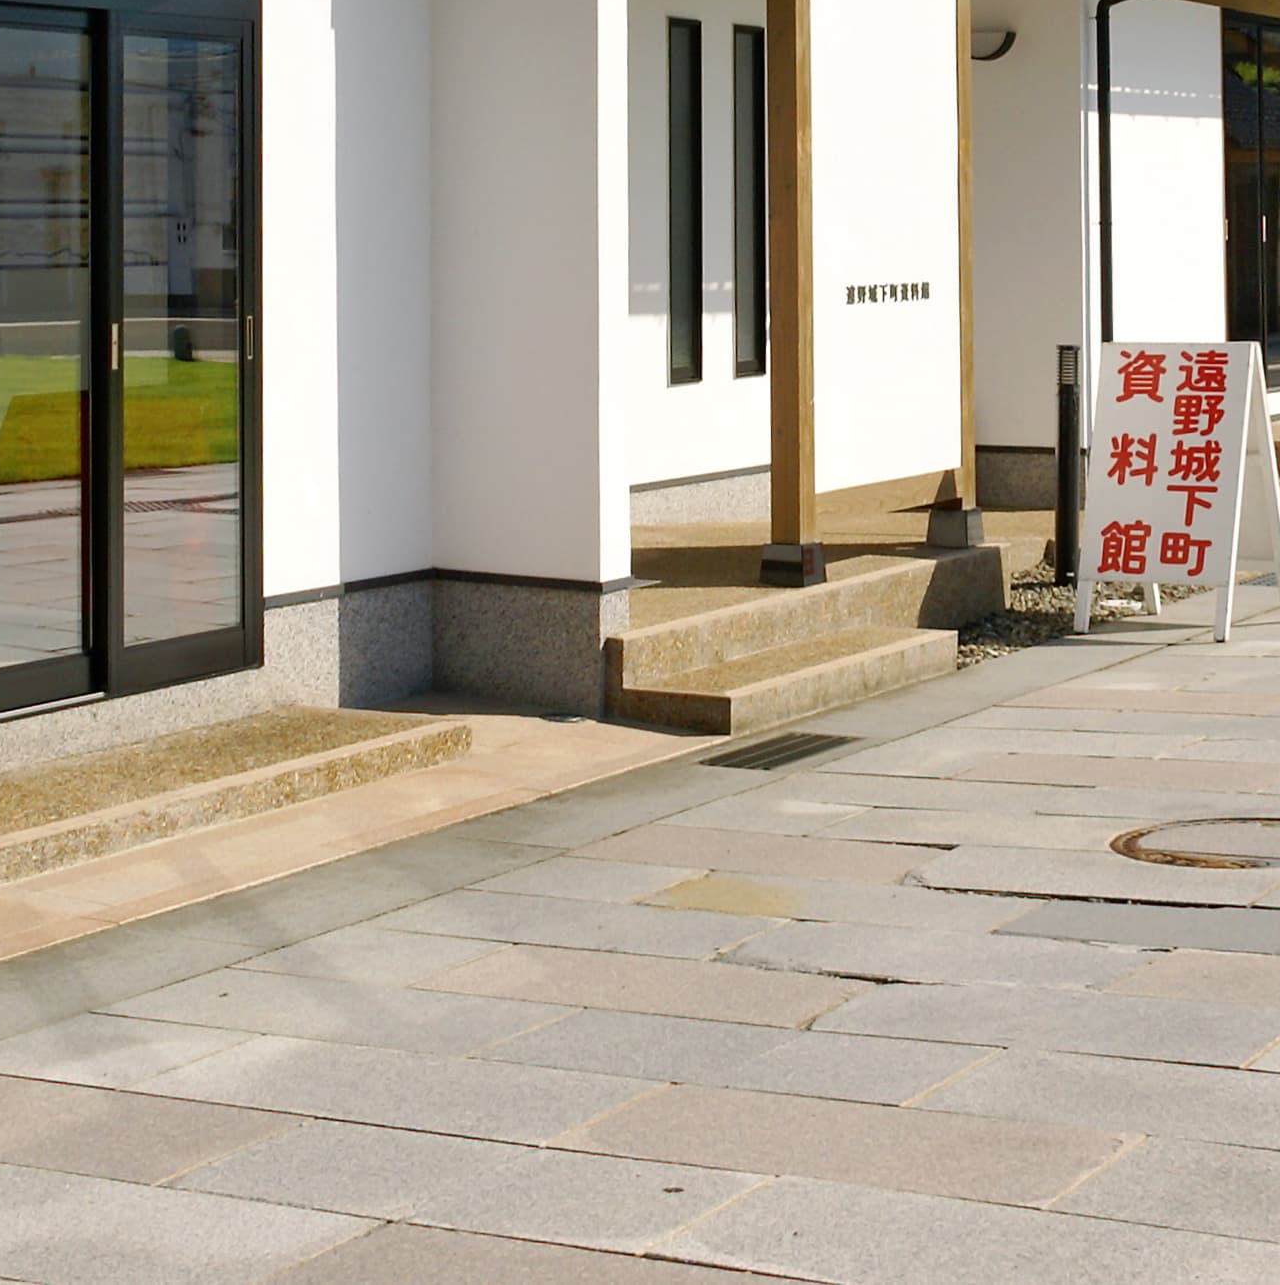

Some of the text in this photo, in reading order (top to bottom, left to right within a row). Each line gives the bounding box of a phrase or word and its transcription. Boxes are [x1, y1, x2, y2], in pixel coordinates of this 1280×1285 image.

[1097, 350, 1167, 576] 資料館
[1160, 350, 1229, 577] 遠野城下町
